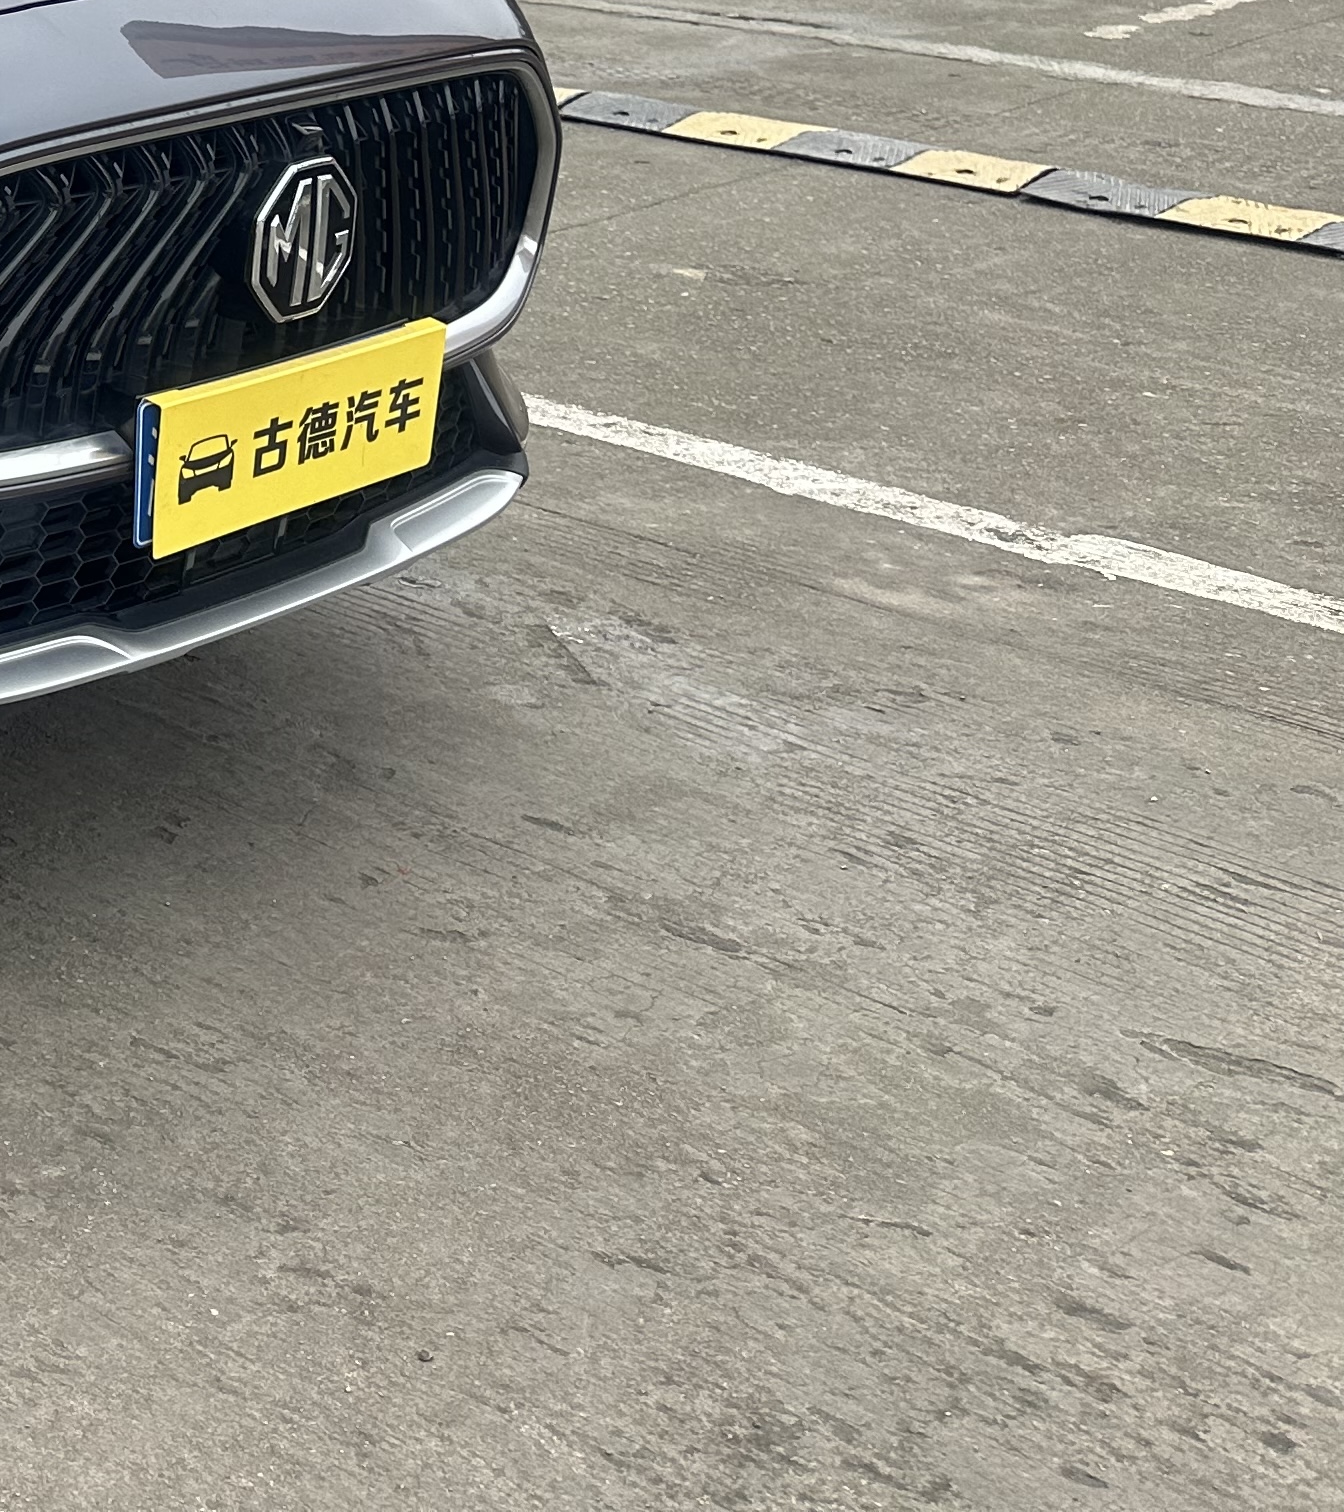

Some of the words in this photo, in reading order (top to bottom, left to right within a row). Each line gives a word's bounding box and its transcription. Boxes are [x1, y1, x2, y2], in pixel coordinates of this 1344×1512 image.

[266, 173, 351, 307] MG
[252, 377, 424, 478] 古德汽车
